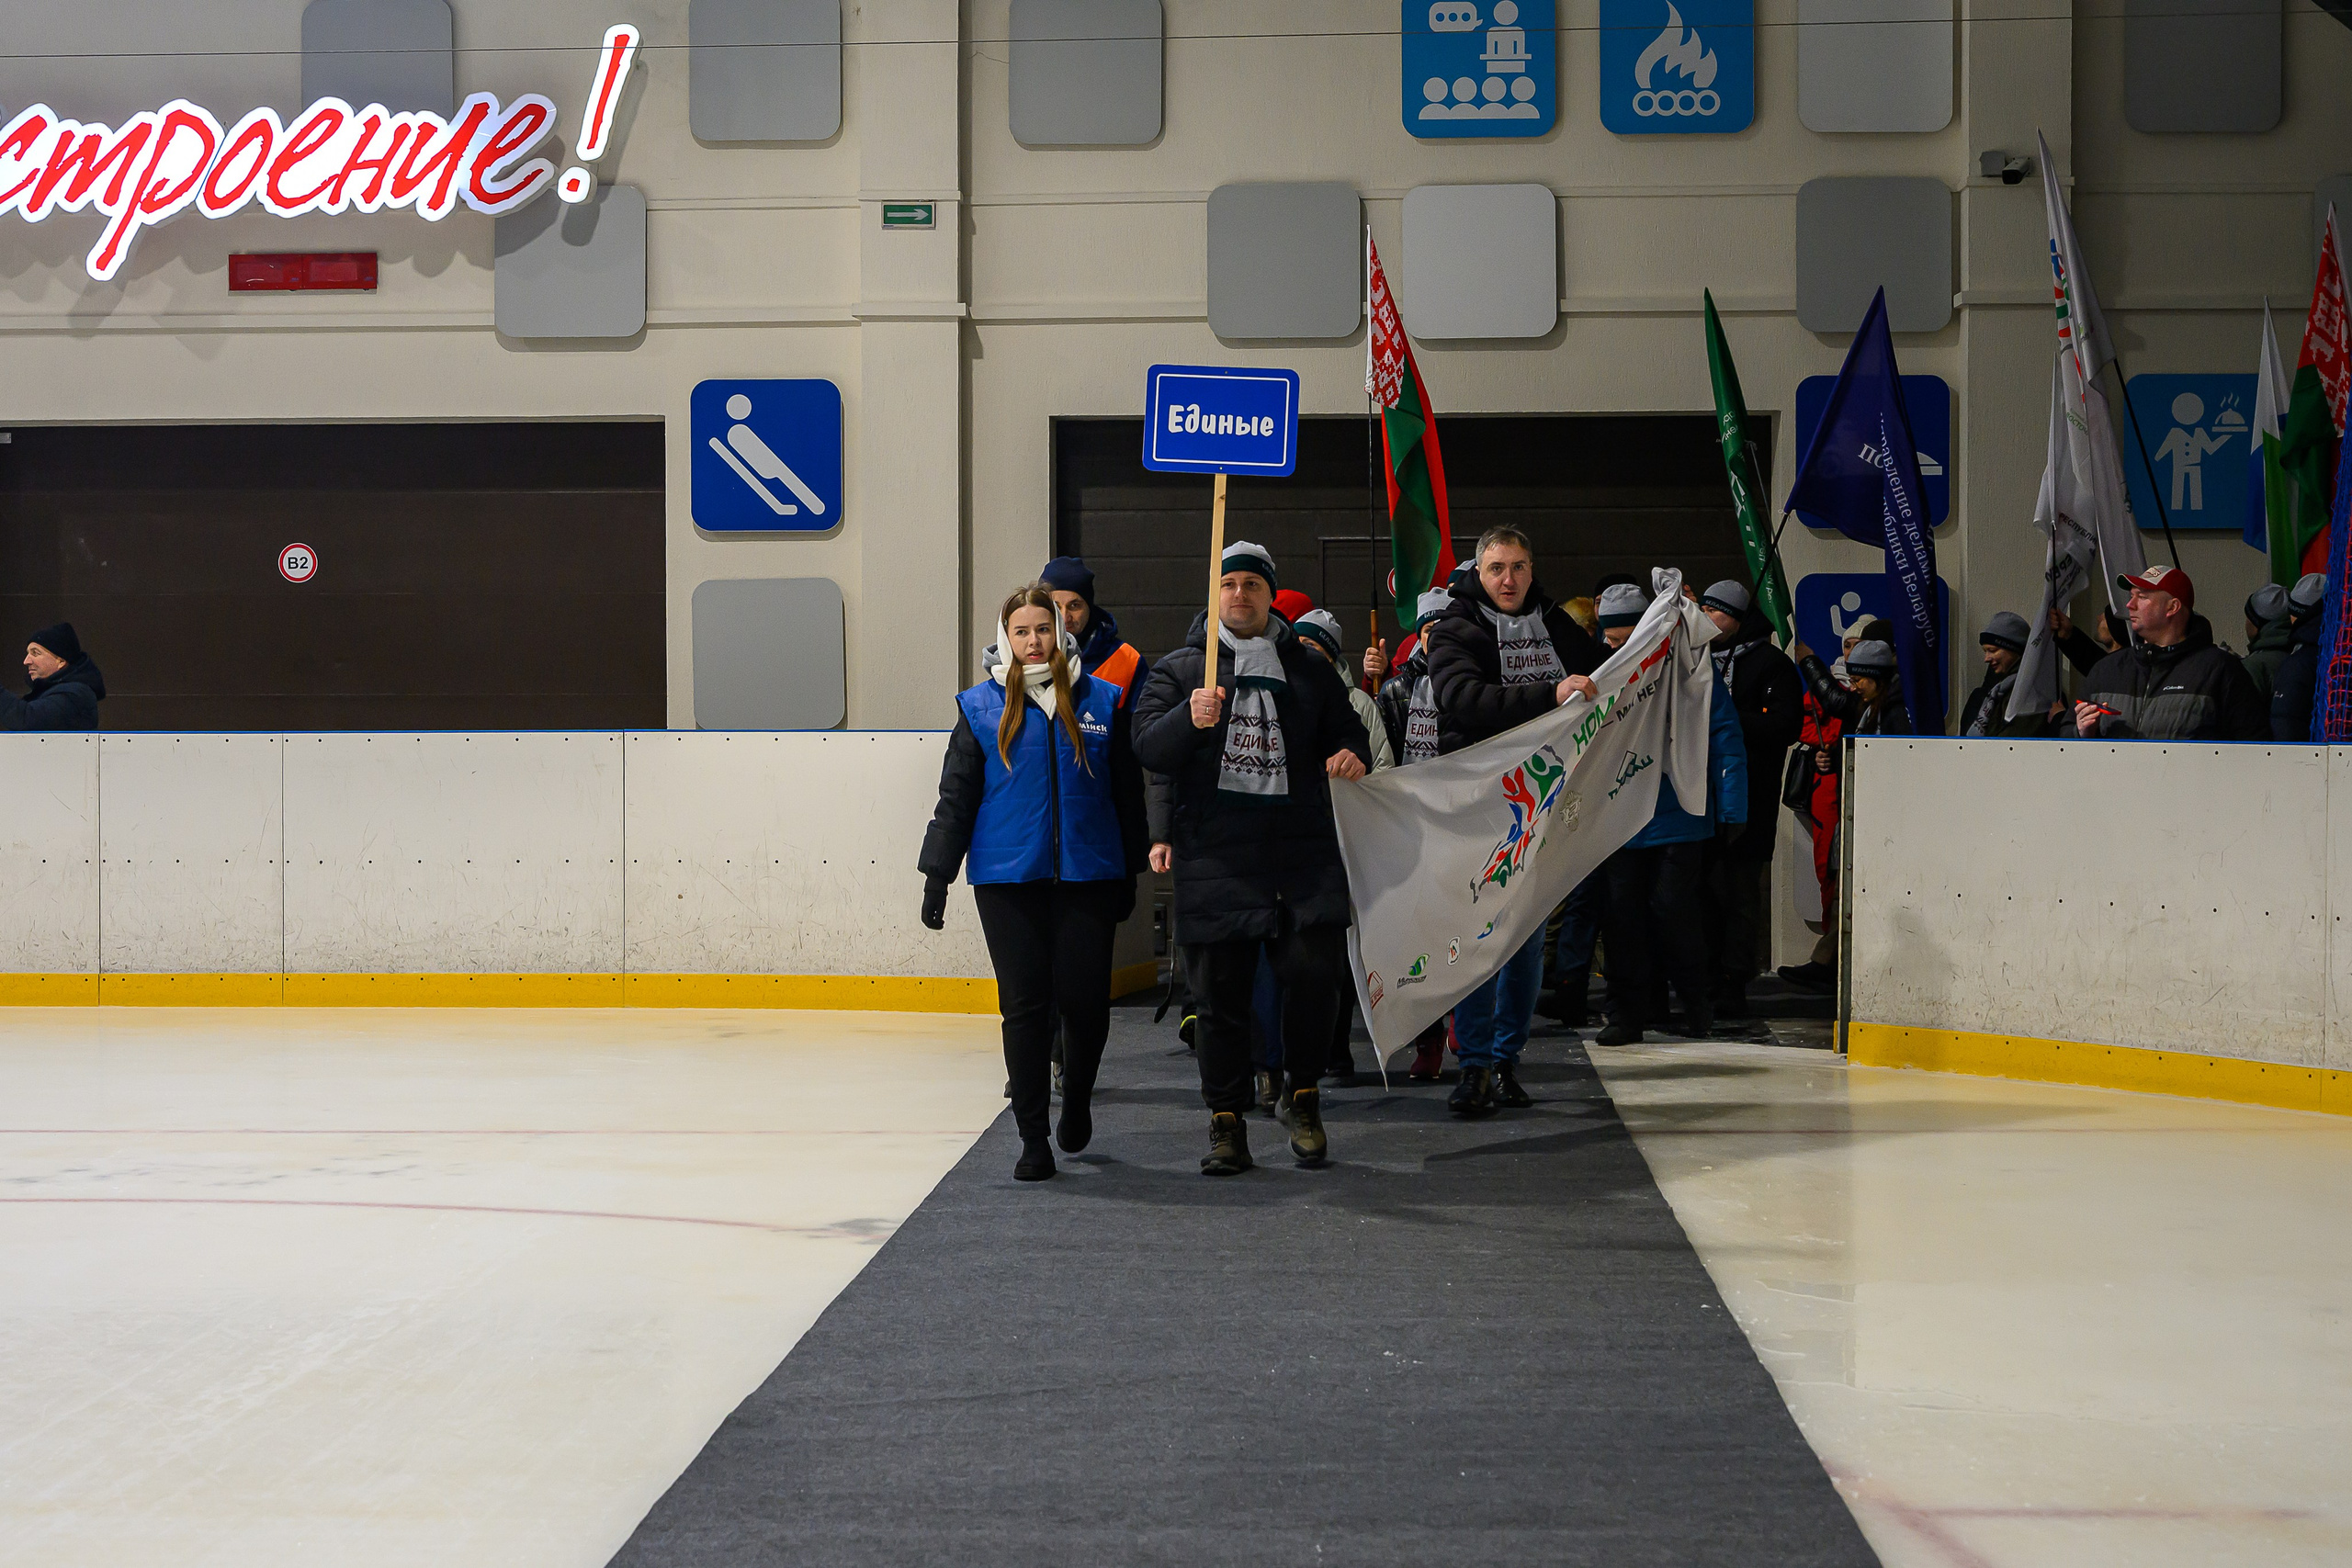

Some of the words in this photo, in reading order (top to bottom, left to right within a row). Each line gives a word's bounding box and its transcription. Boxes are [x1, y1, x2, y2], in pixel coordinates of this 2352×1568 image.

[1168, 403, 1274, 437] Единые
[1902, 571, 1937, 648] Беларусь
[1507, 653, 1553, 671] ЕДИНЫЕ
